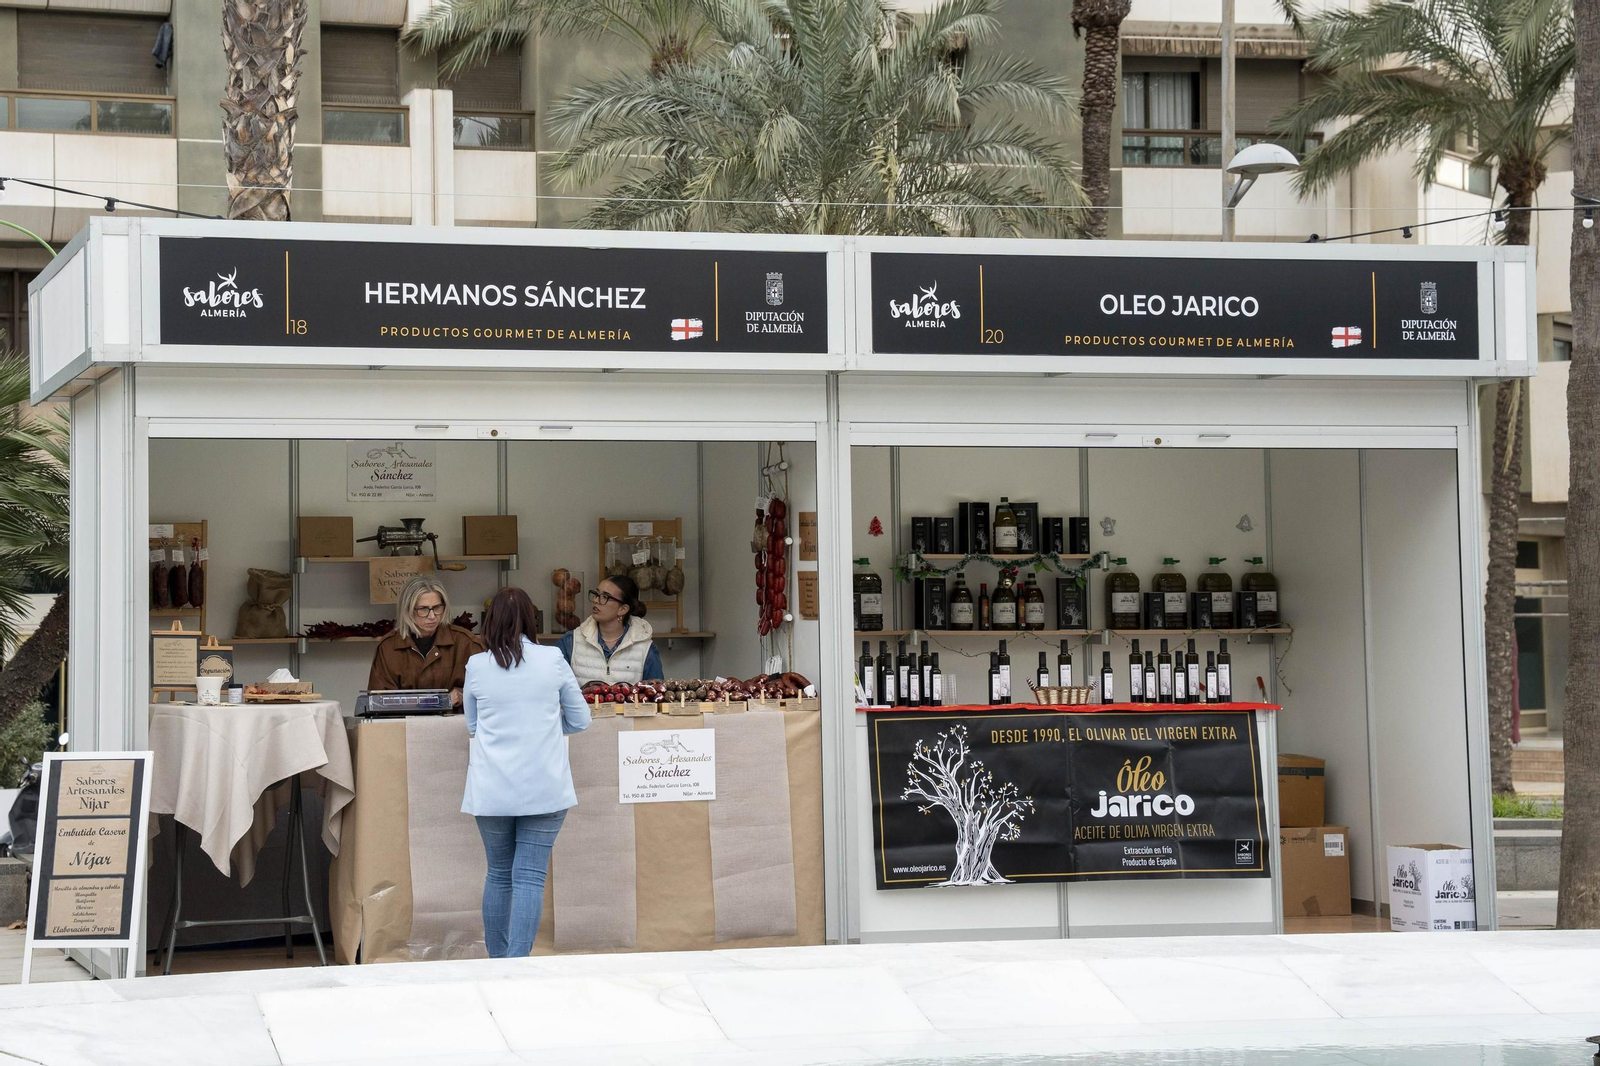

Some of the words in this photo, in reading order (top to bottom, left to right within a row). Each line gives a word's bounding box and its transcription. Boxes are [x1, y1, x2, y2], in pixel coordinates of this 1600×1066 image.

[182, 280, 264, 309] sabores
[365, 282, 517, 307] HERMANOS
[524, 280, 646, 310] SÁNCHEZ
[889, 293, 961, 320] sabores
[1100, 293, 1166, 316] OLEO
[1171, 295, 1260, 317] JARICO
[200, 308, 247, 318] ALMERÍA
[745, 310, 805, 322] DIPUTACIÓN
[290, 319, 308, 335] 18
[746, 323, 759, 333] DE
[761, 321, 804, 334] ALMERÍA
[904, 318, 946, 329] ALMERÍA
[1400, 317, 1458, 330] DIPUTACIÓN
[380, 326, 469, 338] PRODUCTOS
[473, 328, 542, 339] GOURMET
[547, 329, 564, 339] DE
[568, 327, 632, 341] ALMERÍA
[985, 329, 1005, 344] 20
[1402, 331, 1415, 341] DE
[1416, 329, 1457, 342] ALMERÍA
[1064, 335, 1146, 347] PRODUCTOS
[1149, 336, 1213, 348] GOURMET
[1216, 337, 1234, 348] DE
[1236, 335, 1295, 348] ALMERÍA
[351, 459, 385, 469] Sabores
[385, 459, 433, 470] Artesanales
[370, 468, 414, 482] Sánchez
[991, 729, 1028, 744] DESDE
[1033, 728, 1066, 744] 1990,
[1068, 727, 1083, 741] EL
[1086, 727, 1127, 741] OLIVAR
[1130, 727, 1152, 741] DEL
[1155, 726, 1198, 740] VIRGEN
[1202, 726, 1237, 740] EXTRA
[622, 755, 660, 767] Sabores
[660, 753, 712, 766] Artesanales
[644, 765, 691, 781] Sánchez
[1116, 755, 1167, 793] Óleo
[76, 776, 116, 786] Sabores
[66, 785, 125, 795] Artesanales
[79, 796, 110, 813] Níjar
[1090, 791, 1196, 818] jarico
[57, 827, 97, 838] Embutido
[98, 826, 127, 836] Casero
[1074, 825, 1106, 840] ACEITE
[1109, 825, 1121, 839] DE
[1124, 824, 1150, 838] OLIVA
[1152, 824, 1184, 838] VIRGEN
[1187, 823, 1216, 837] EXTRA
[1123, 846, 1153, 855] Extracción
[1162, 845, 1173, 854] frío
[68, 850, 112, 870] Níjar
[1122, 857, 1148, 866] Producto
[1148, 857, 1156, 866] de
[1156, 857, 1177, 867] España
[892, 864, 947, 874] www.oleojarico.es
[52, 925, 90, 934] Elaboración
[91, 924, 115, 934] Propia
